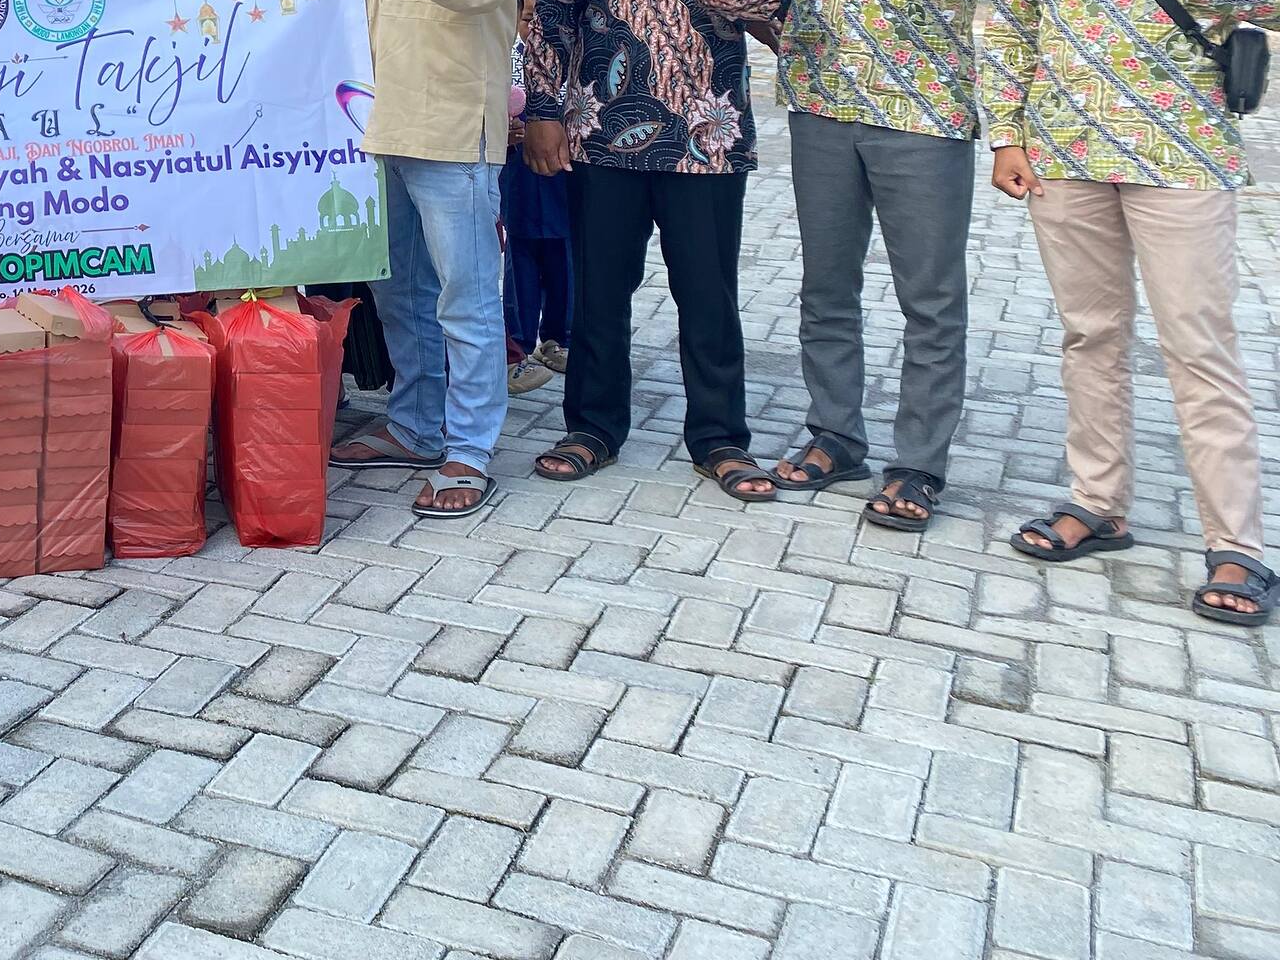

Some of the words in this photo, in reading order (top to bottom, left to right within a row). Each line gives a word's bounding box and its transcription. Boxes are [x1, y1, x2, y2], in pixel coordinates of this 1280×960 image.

[56, 1, 251, 126] Takjil
[57, 157, 83, 182] &
[89, 145, 232, 183] Nasyiatul
[240, 138, 367, 175] Aisyiyah
[43, 186, 130, 216] Modo
